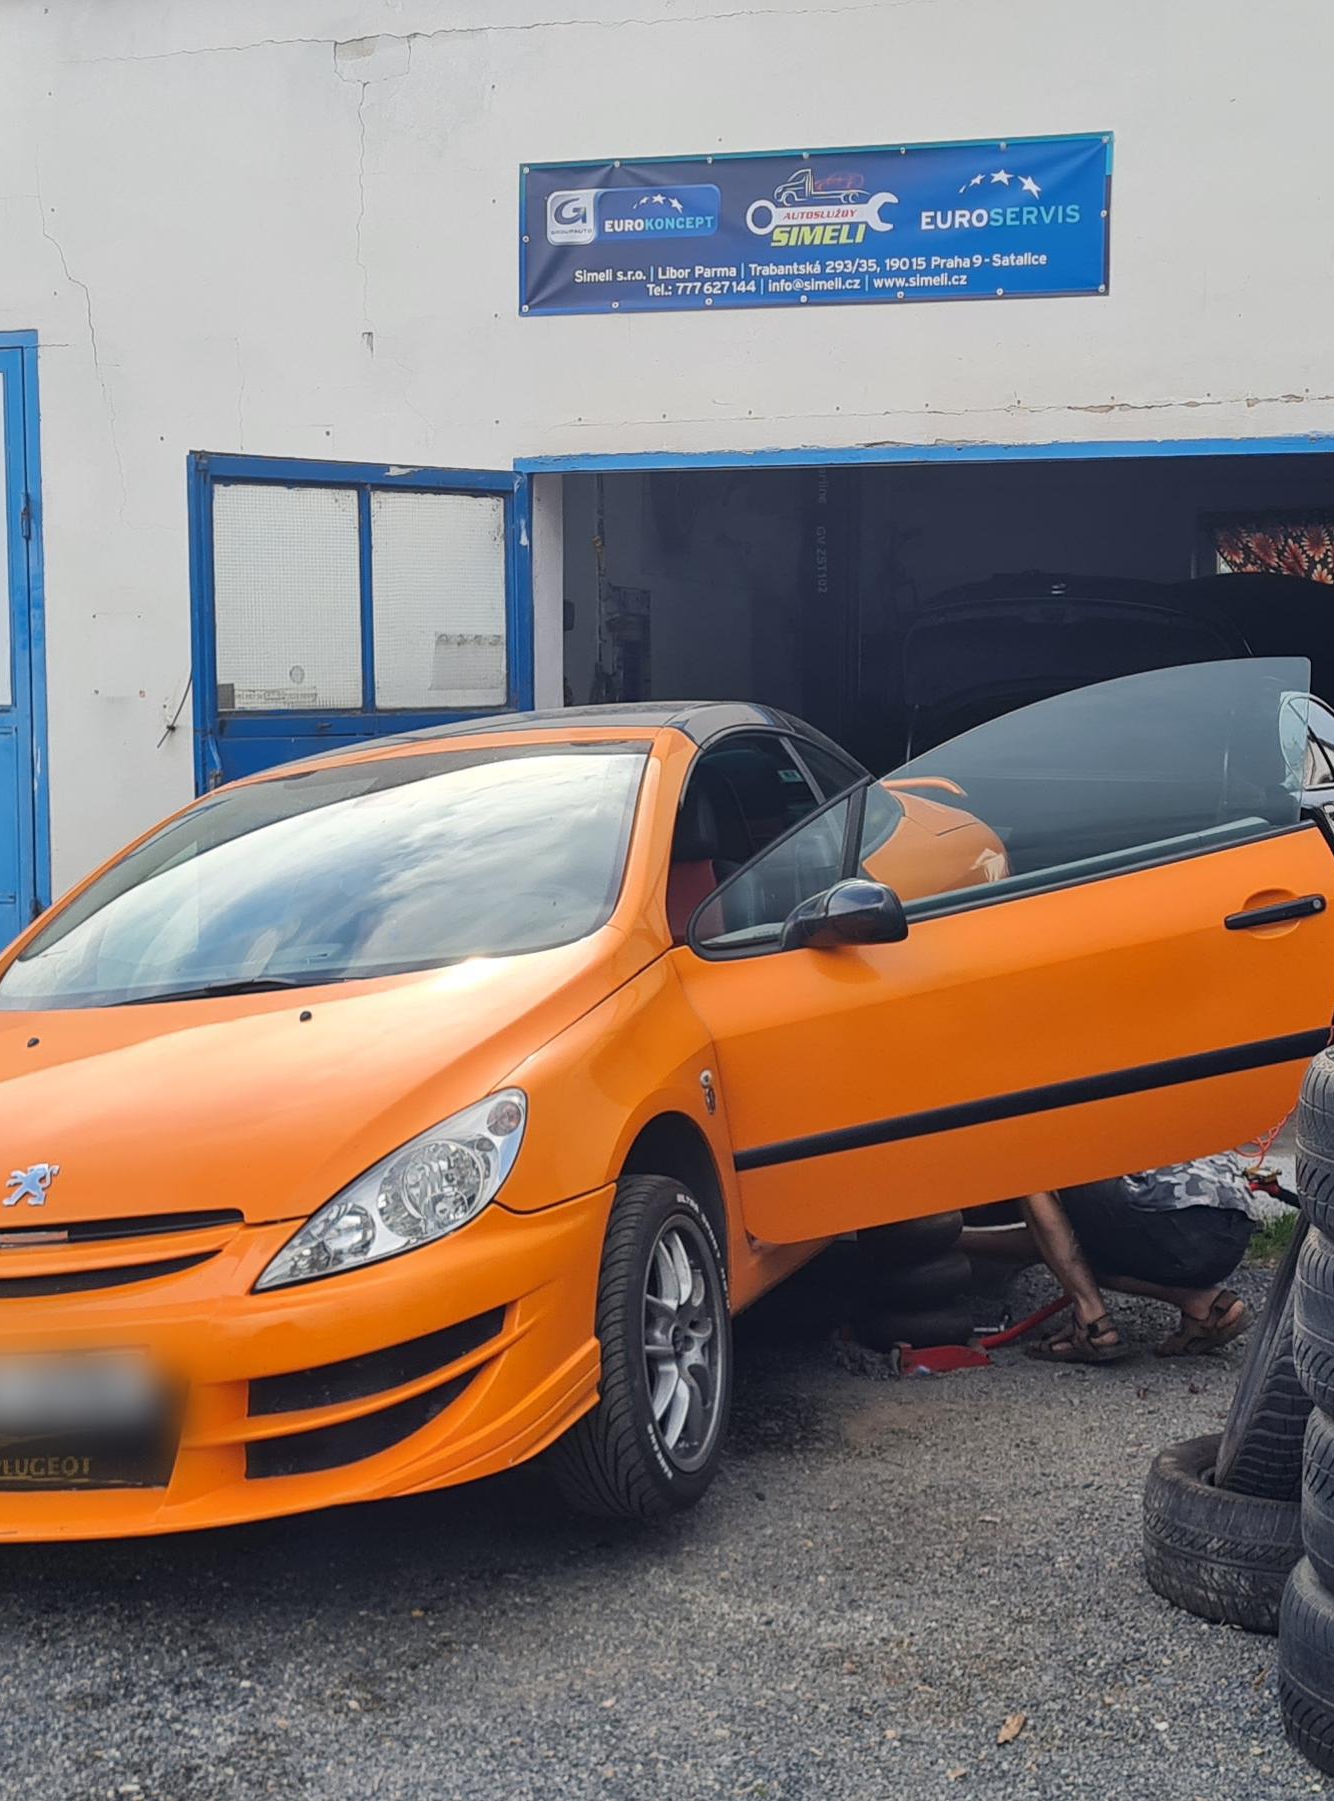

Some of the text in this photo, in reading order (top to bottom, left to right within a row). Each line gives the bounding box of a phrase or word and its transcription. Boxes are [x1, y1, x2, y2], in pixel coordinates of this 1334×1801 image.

[604, 216, 714, 233] EUROKONCEPT
[920, 204, 1081, 230] EUROSERVIS
[770, 223, 867, 247] SIMELI
[574, 268, 613, 283] Simeli
[616, 270, 646, 282] s.r.o.
[658, 266, 691, 280] Libor
[695, 264, 737, 278] Parma
[749, 261, 821, 277] Trabantská
[825, 258, 881, 274] 293/35,
[931, 254, 970, 269] Praha
[992, 252, 1047, 267] Satalice
[647, 283, 672, 297] Tel.:
[768, 276, 861, 292] info@simeli.cz
[873, 272, 967, 289] www.simeli.cz
